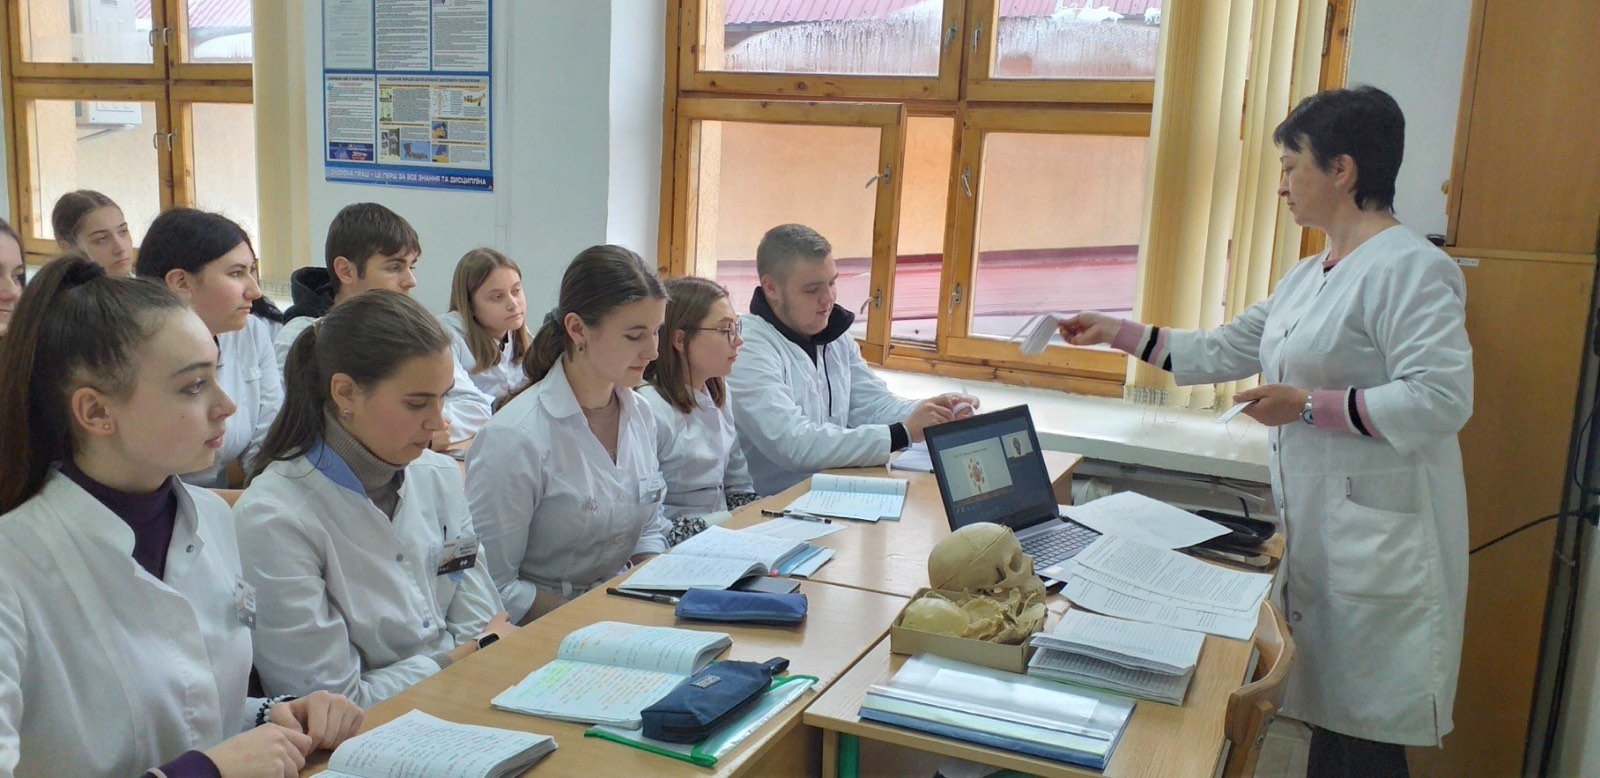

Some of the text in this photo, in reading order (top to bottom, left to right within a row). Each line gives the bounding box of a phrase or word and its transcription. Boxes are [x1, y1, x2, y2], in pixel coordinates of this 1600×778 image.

[407, 173, 417, 181] ВСЕ
[418, 174, 440, 182] ЗНАННЯ
[441, 175, 449, 183] ТА
